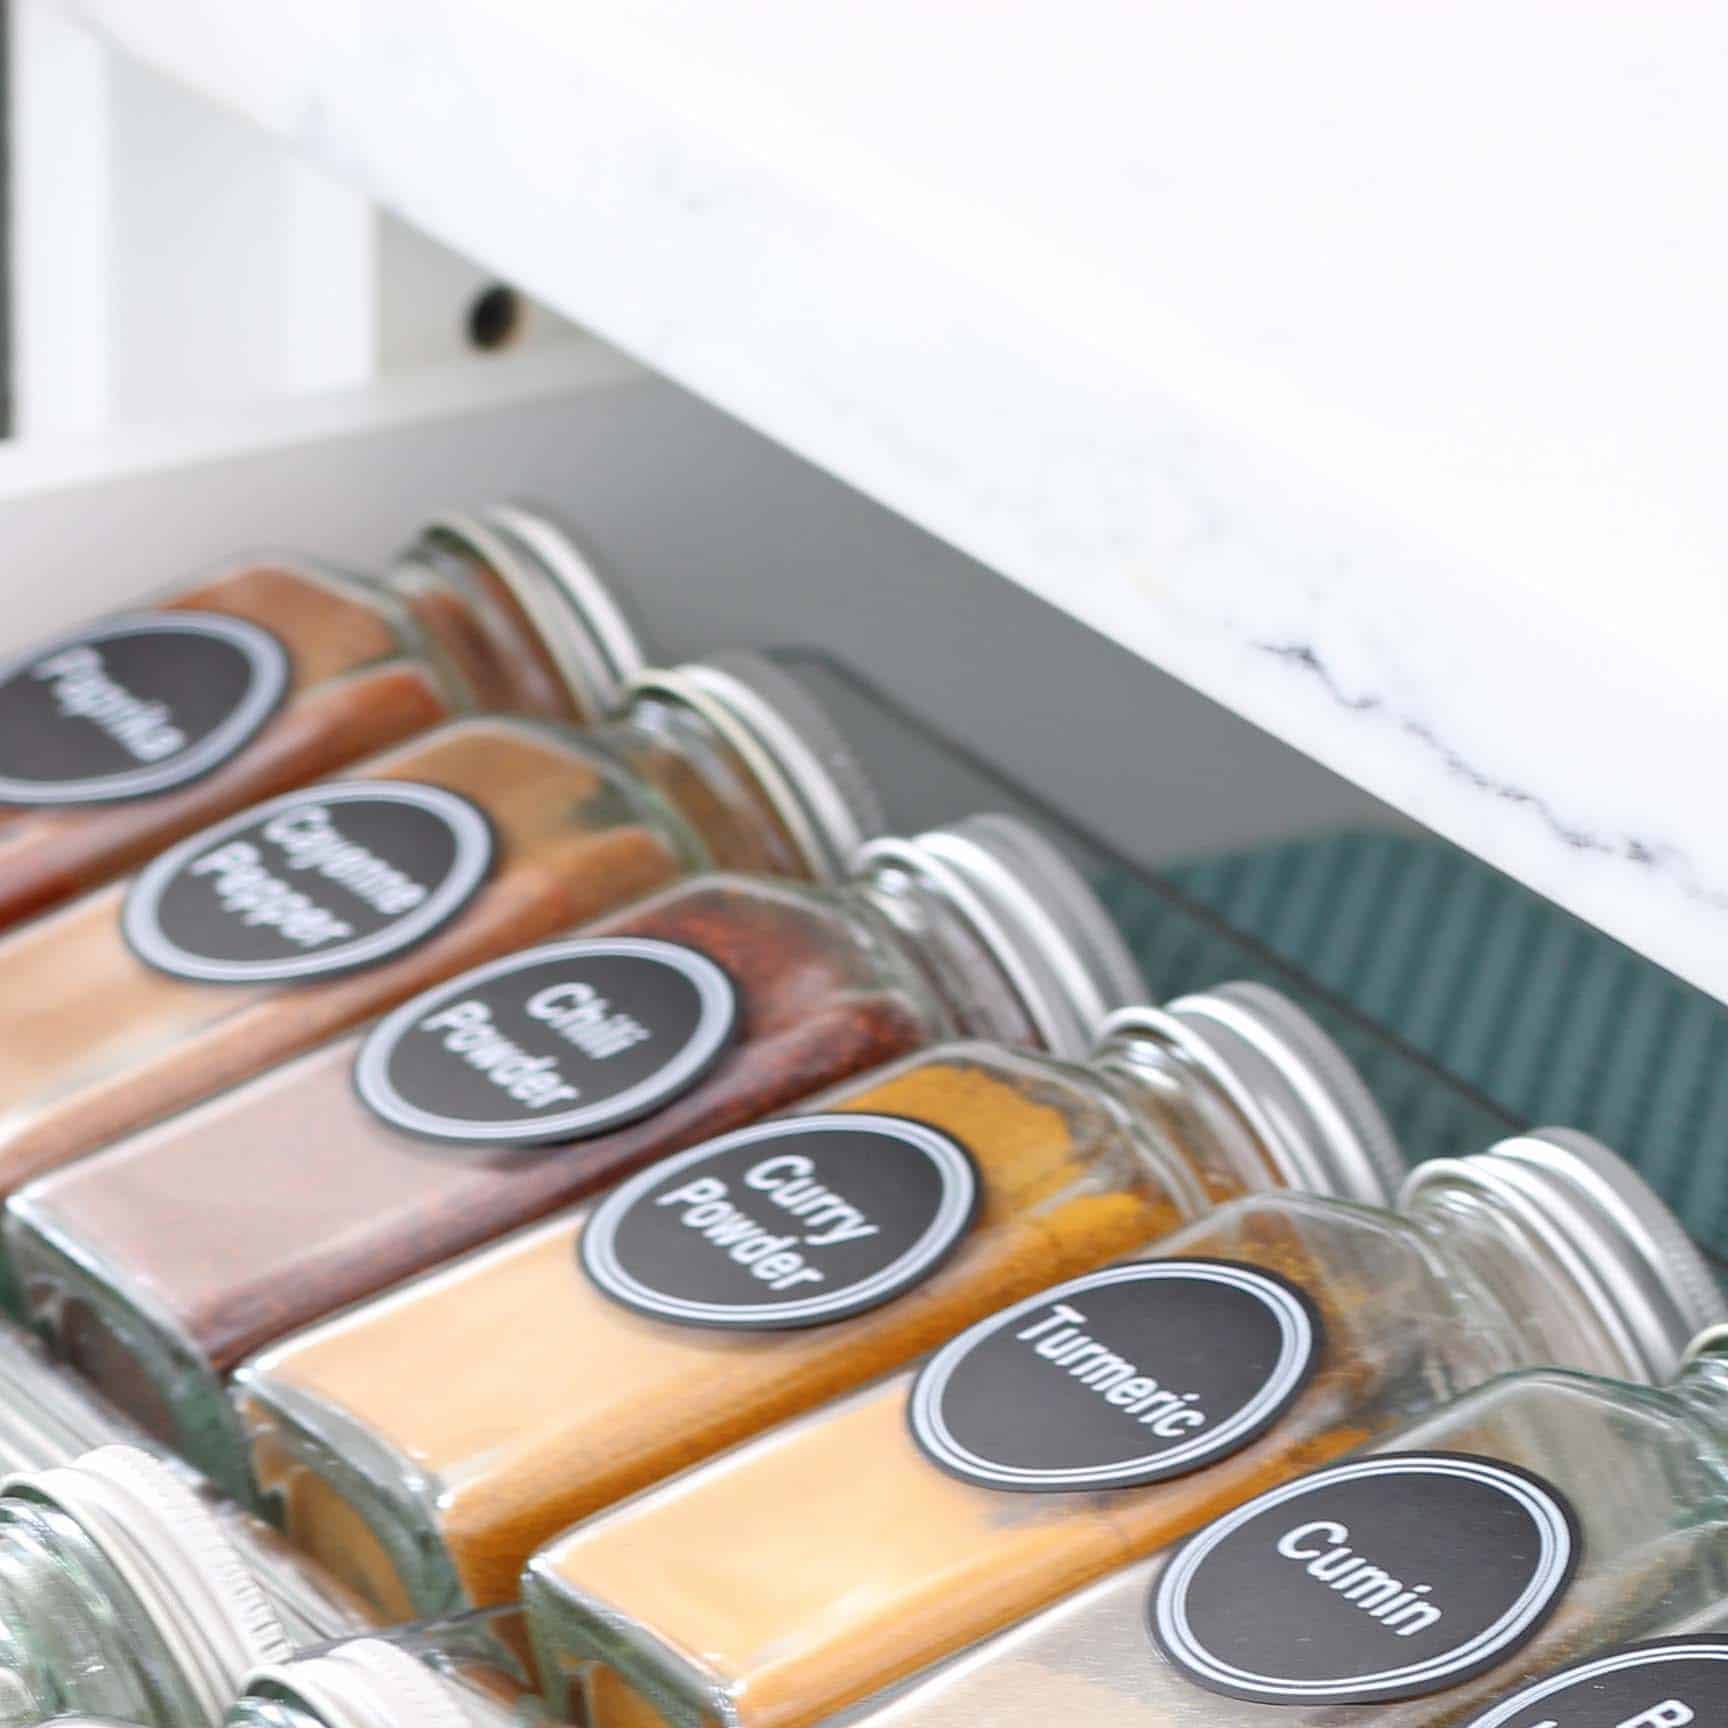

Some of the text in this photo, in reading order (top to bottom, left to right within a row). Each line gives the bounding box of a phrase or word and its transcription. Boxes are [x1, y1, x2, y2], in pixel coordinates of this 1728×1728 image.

[30, 646, 186, 763] Paprika
[190, 839, 354, 947] Pepper
[264, 803, 428, 915] Cayenne
[420, 1000, 580, 1109] Powder
[525, 981, 652, 1060] Chili
[654, 1176, 825, 1291] Powder
[743, 1154, 880, 1246] Curry
[1016, 1304, 1207, 1440] Turmeric
[1275, 1519, 1444, 1639] Cumin
